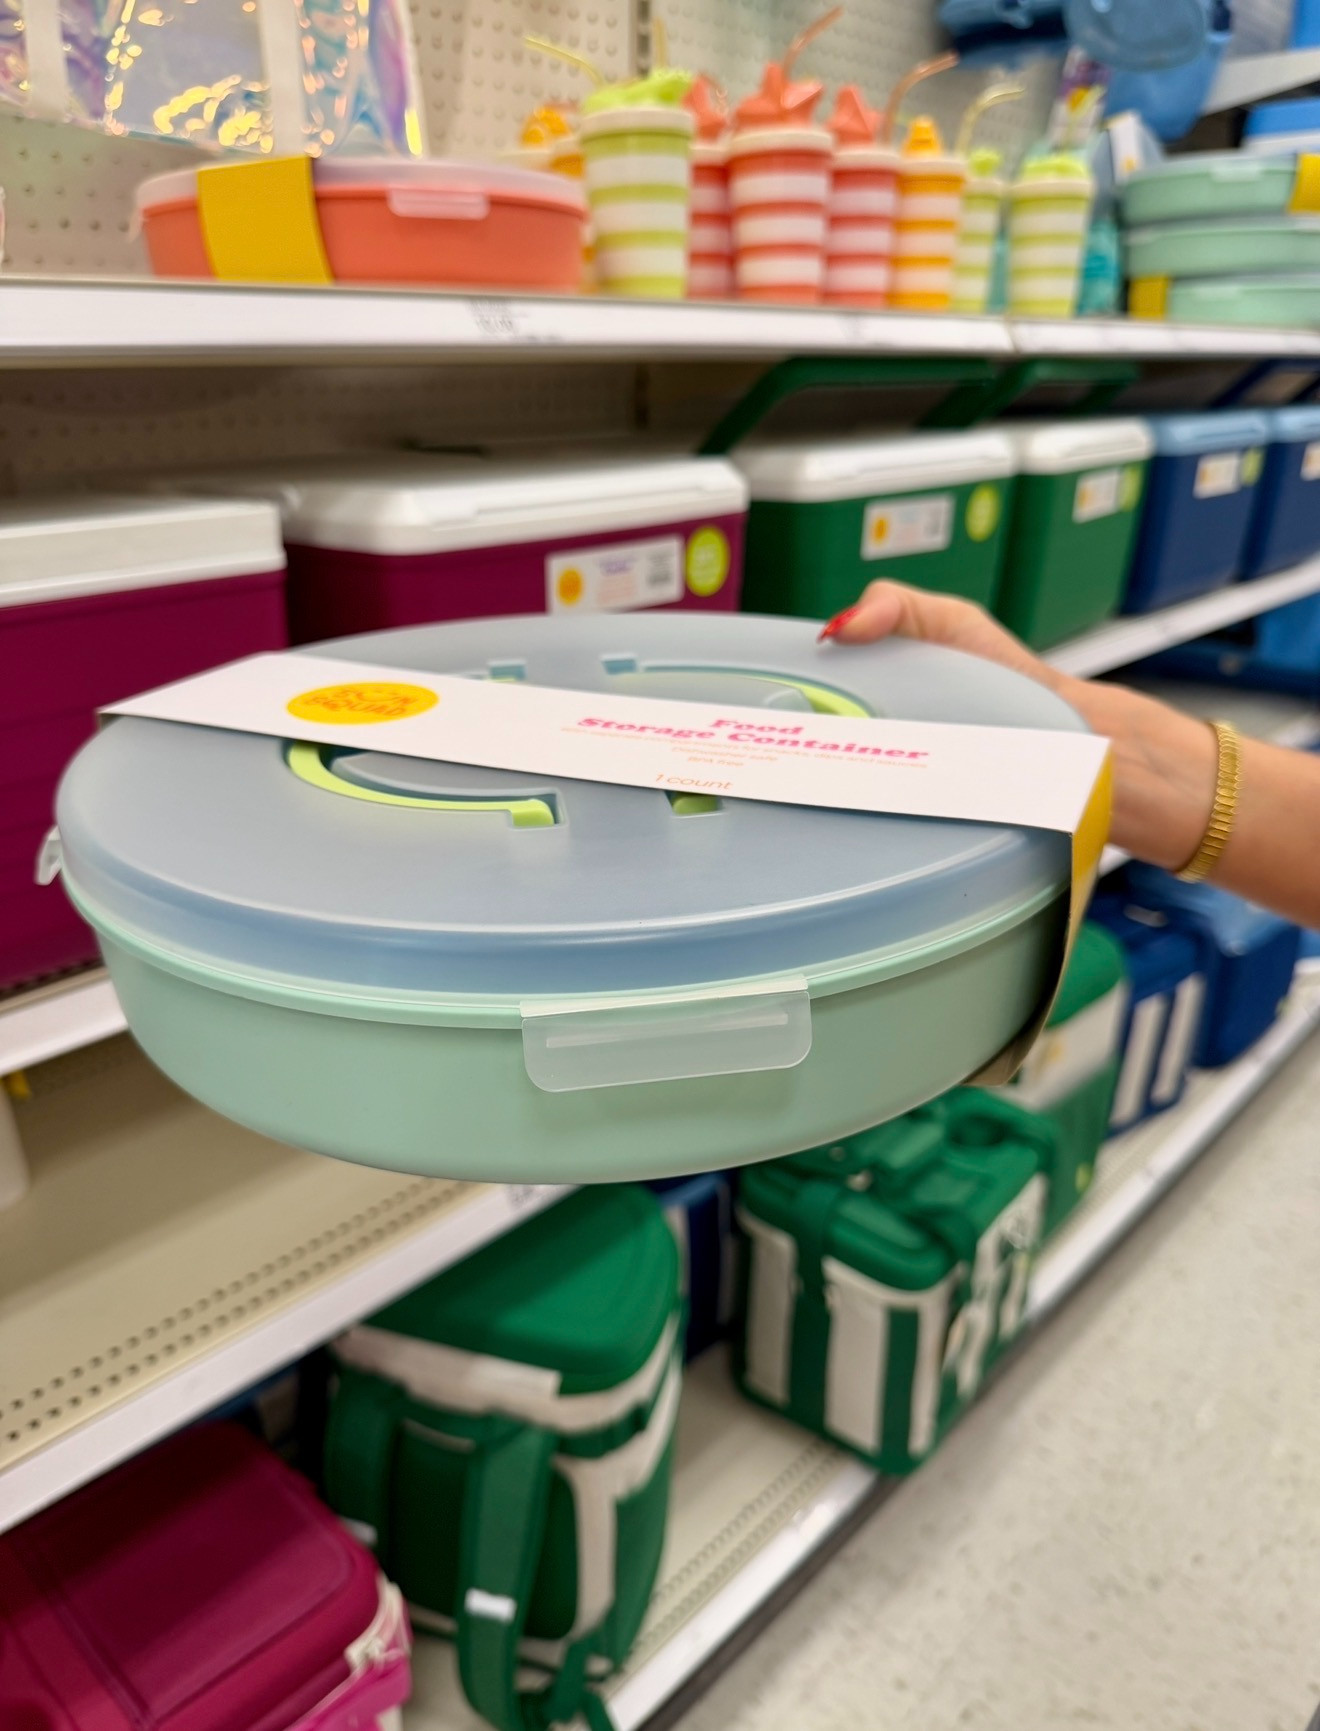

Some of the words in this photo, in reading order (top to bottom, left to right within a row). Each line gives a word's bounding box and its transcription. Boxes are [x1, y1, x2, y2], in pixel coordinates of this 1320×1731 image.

[709, 719, 804, 735] Food
[577, 718, 716, 738] Storage
[727, 732, 929, 759] Container
[667, 777, 734, 790] count
